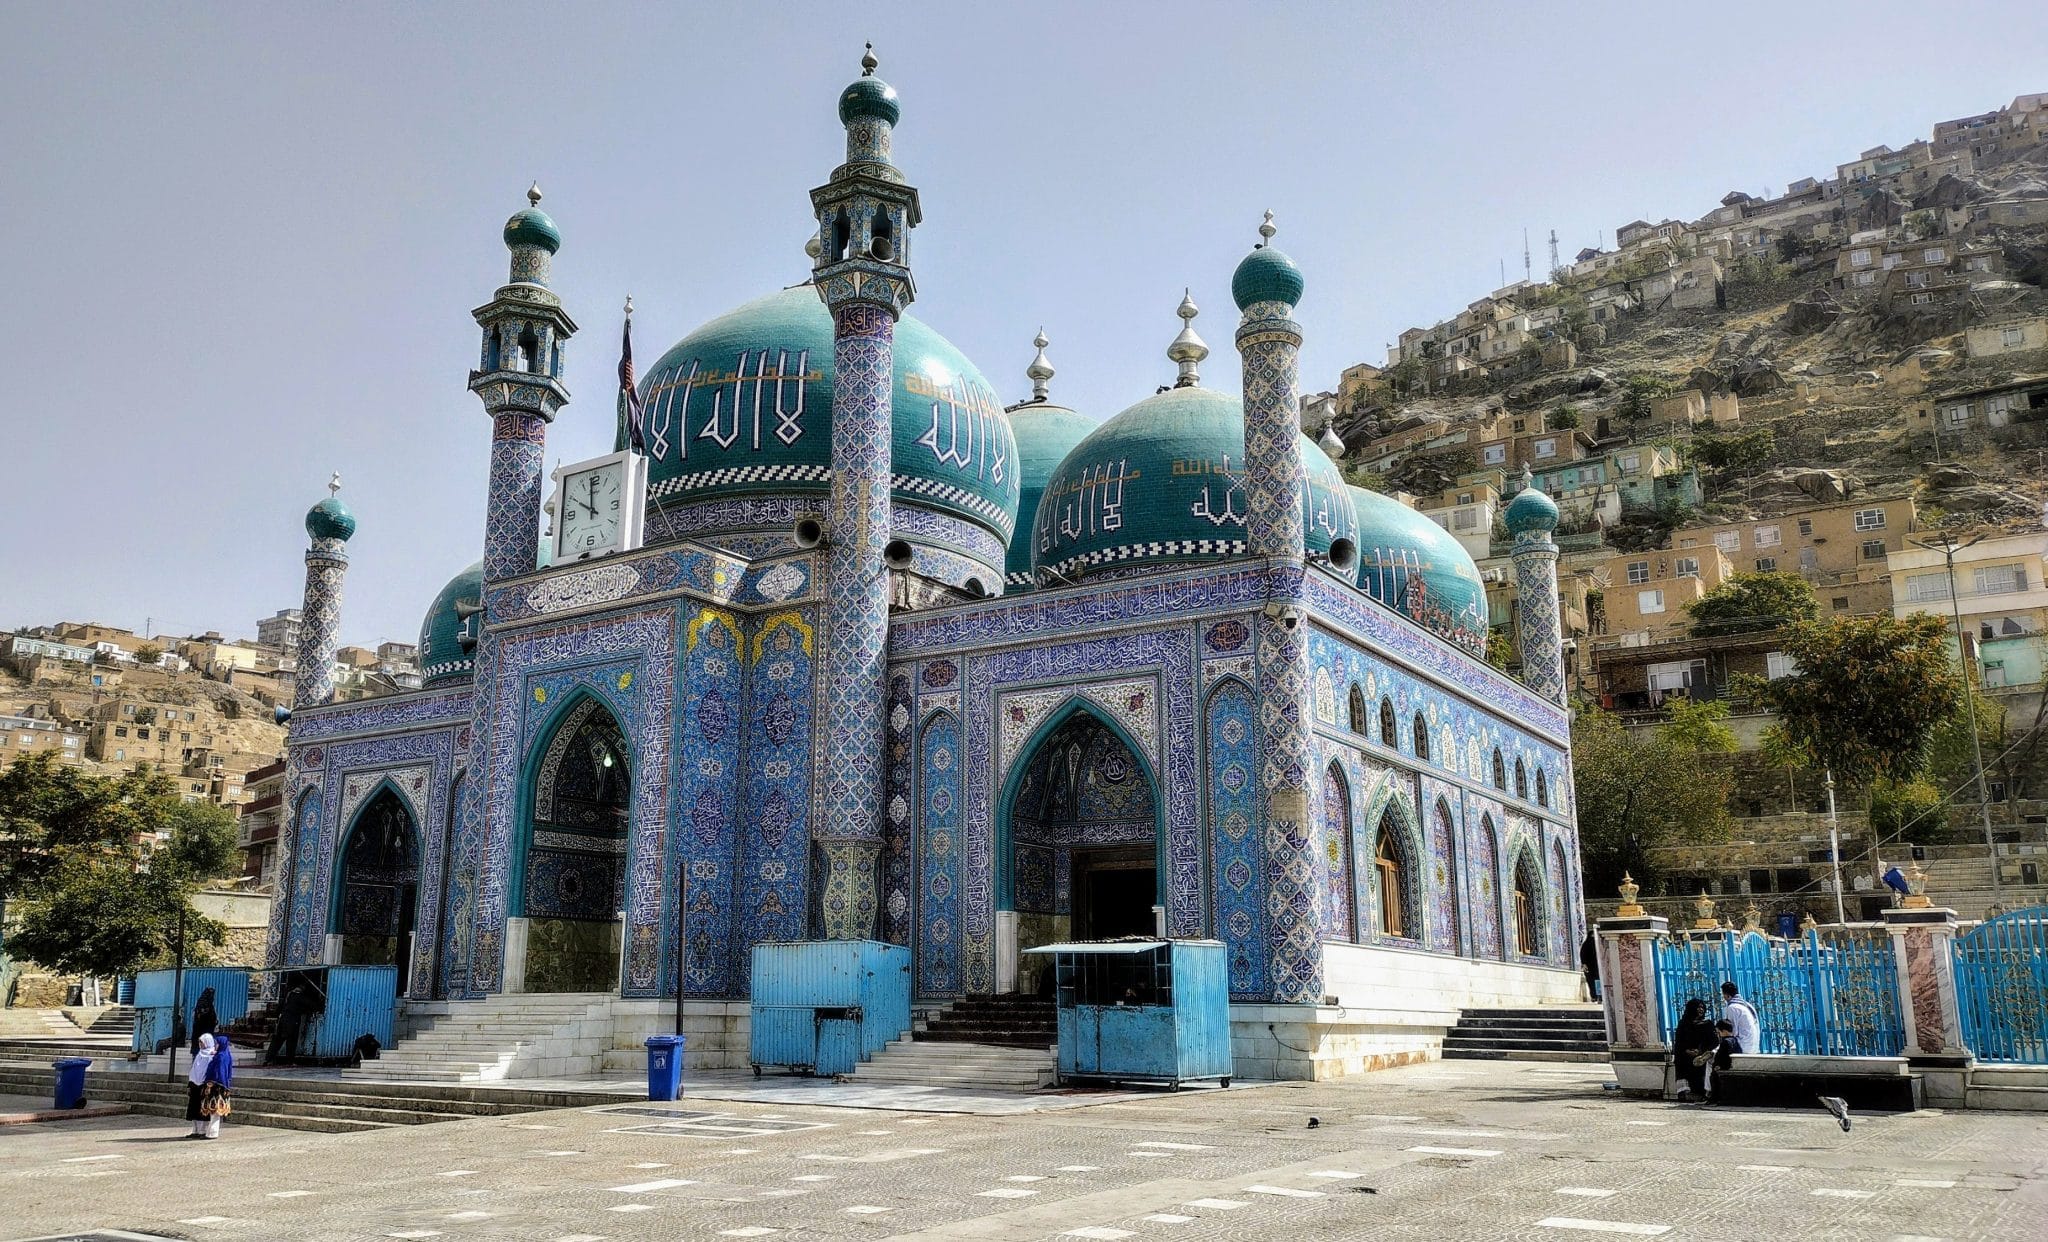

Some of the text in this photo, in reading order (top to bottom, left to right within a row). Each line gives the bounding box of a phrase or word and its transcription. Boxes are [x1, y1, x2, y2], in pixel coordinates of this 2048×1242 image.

[611, 500, 619, 510] 3
[568, 511, 575, 520] 9
[587, 536, 595, 546] 6
